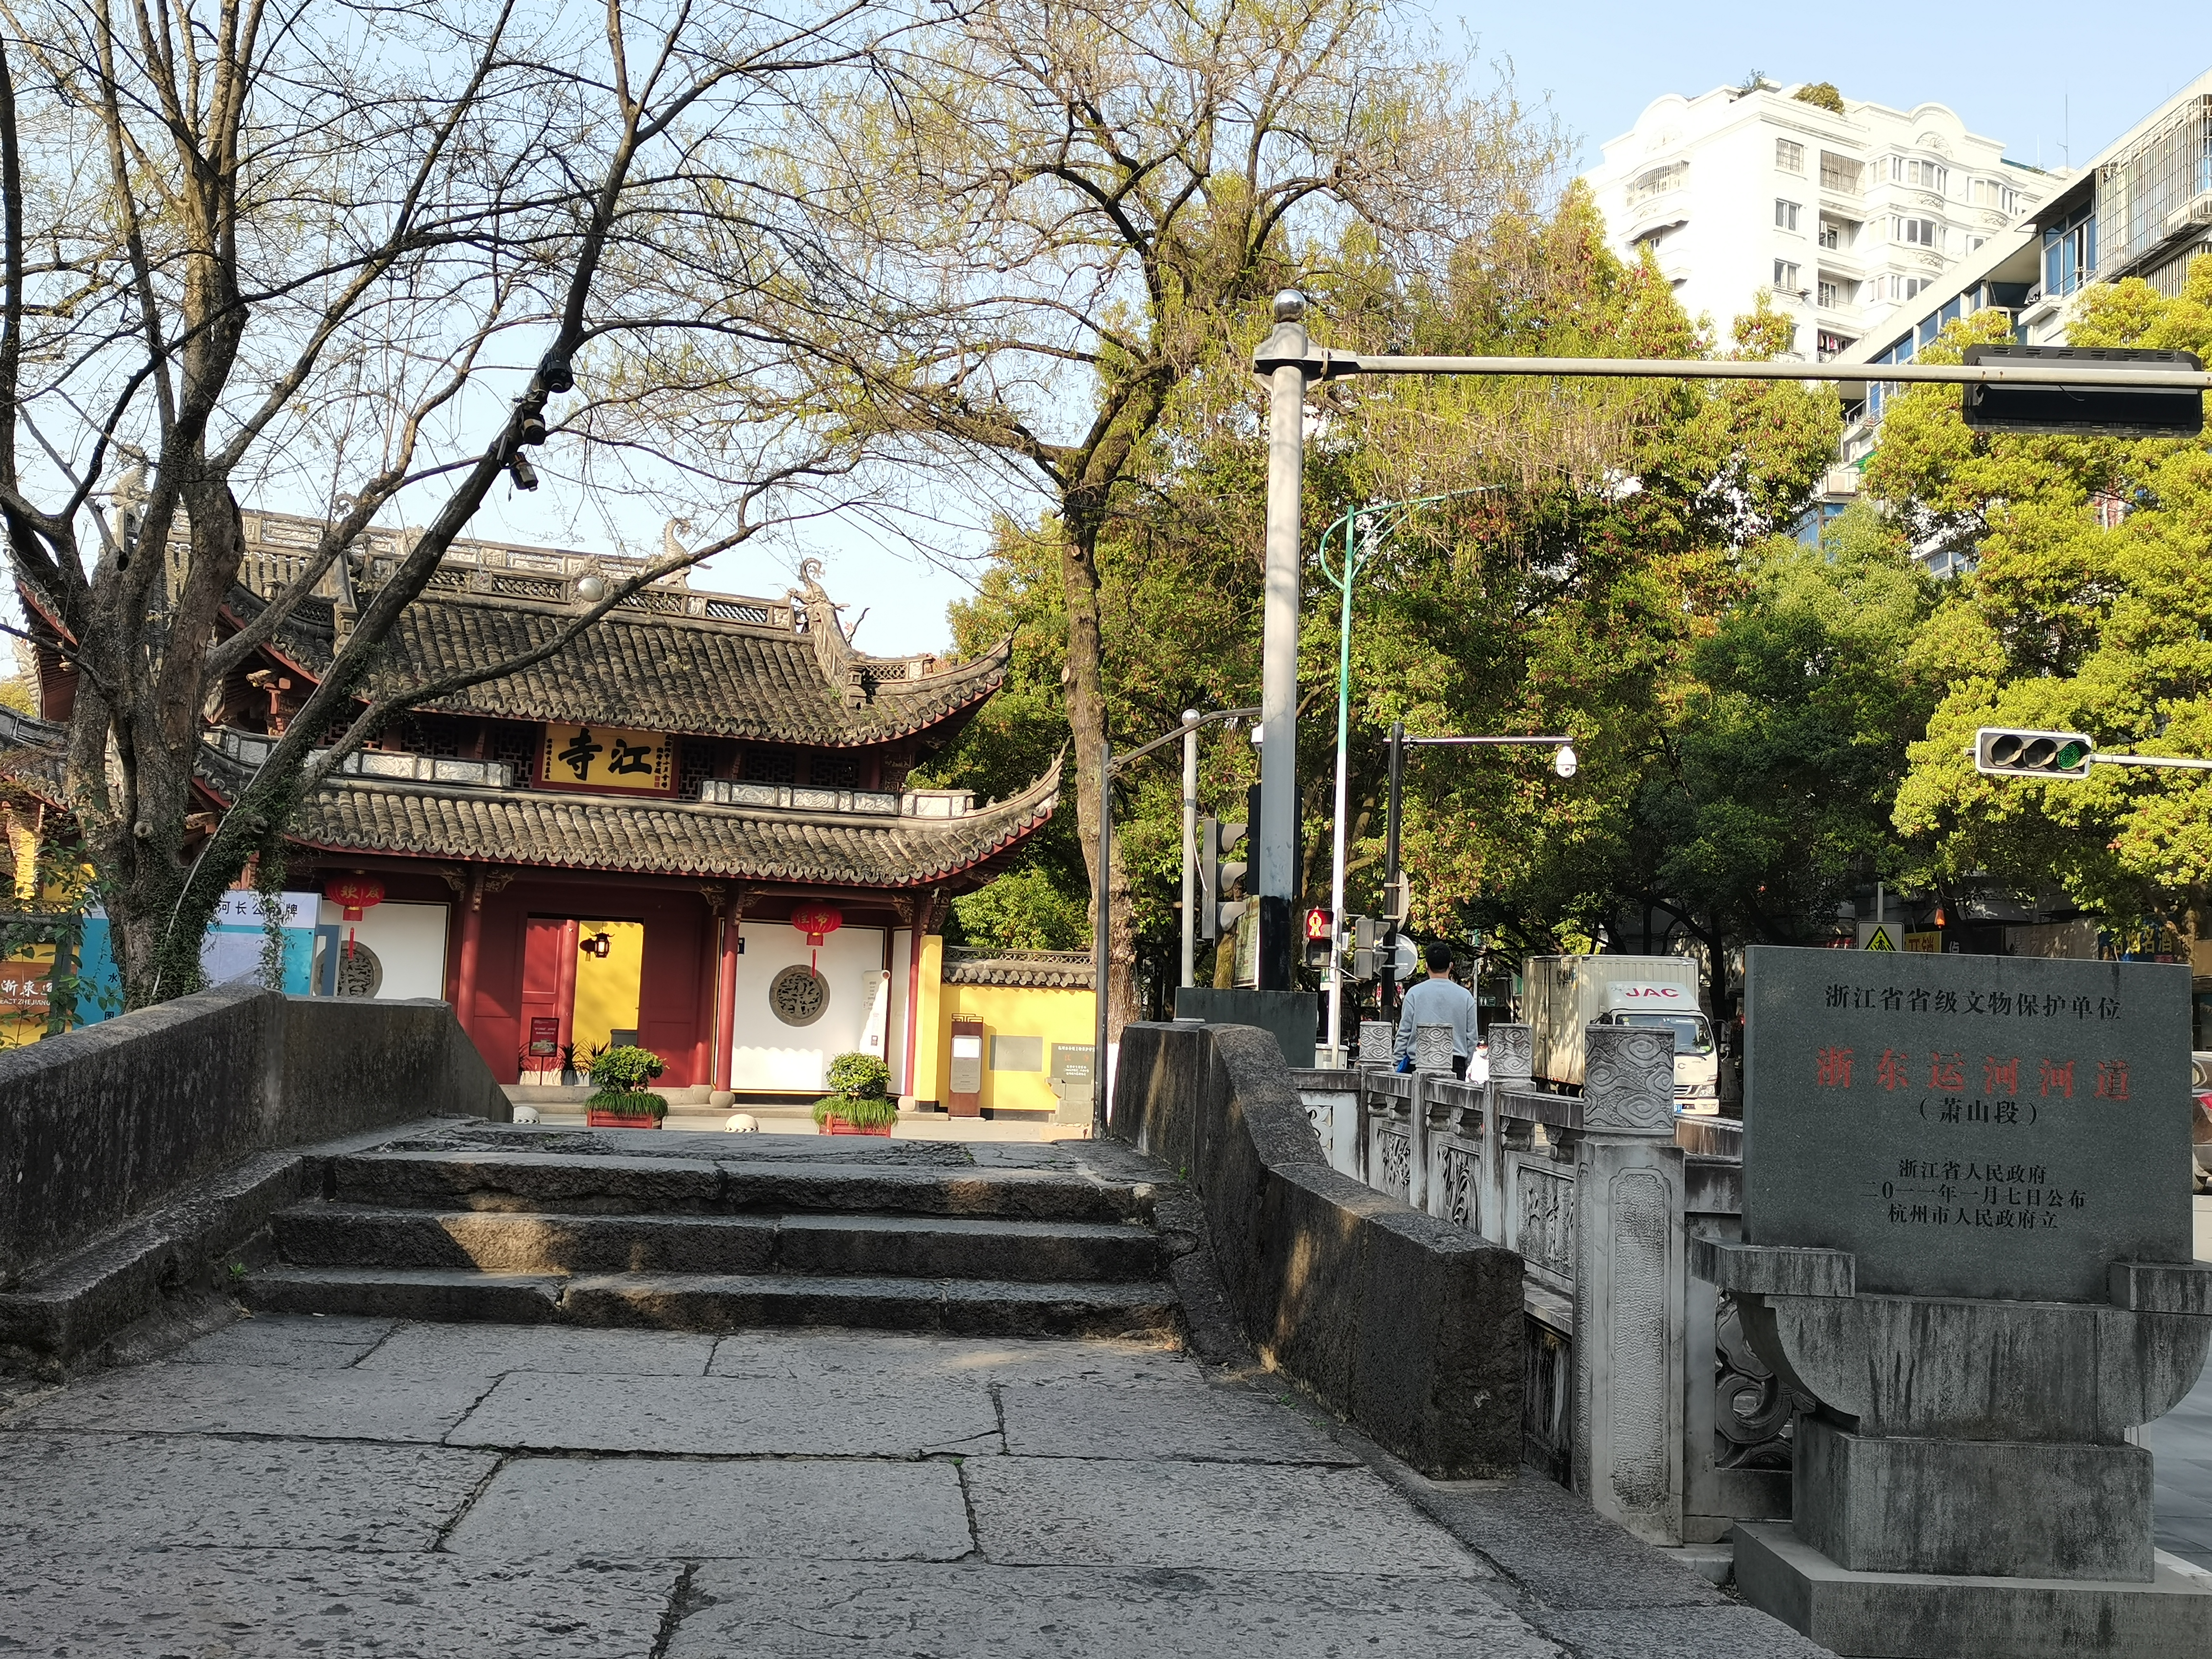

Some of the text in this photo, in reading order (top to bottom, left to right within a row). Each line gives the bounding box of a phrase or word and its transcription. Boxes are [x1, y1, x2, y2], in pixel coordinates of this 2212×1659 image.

[217, 901, 298, 917] 河长公牌
[1625, 987, 1680, 998] JAC
[1825, 984, 2121, 1021] 浙江省省级文物保护单位
[1816, 1046, 2132, 1101] 浙东运河河道
[1898, 1158, 2047, 1185] 浙江省人民政府
[1887, 1203, 2058, 1229] 杭州市人民政府立
